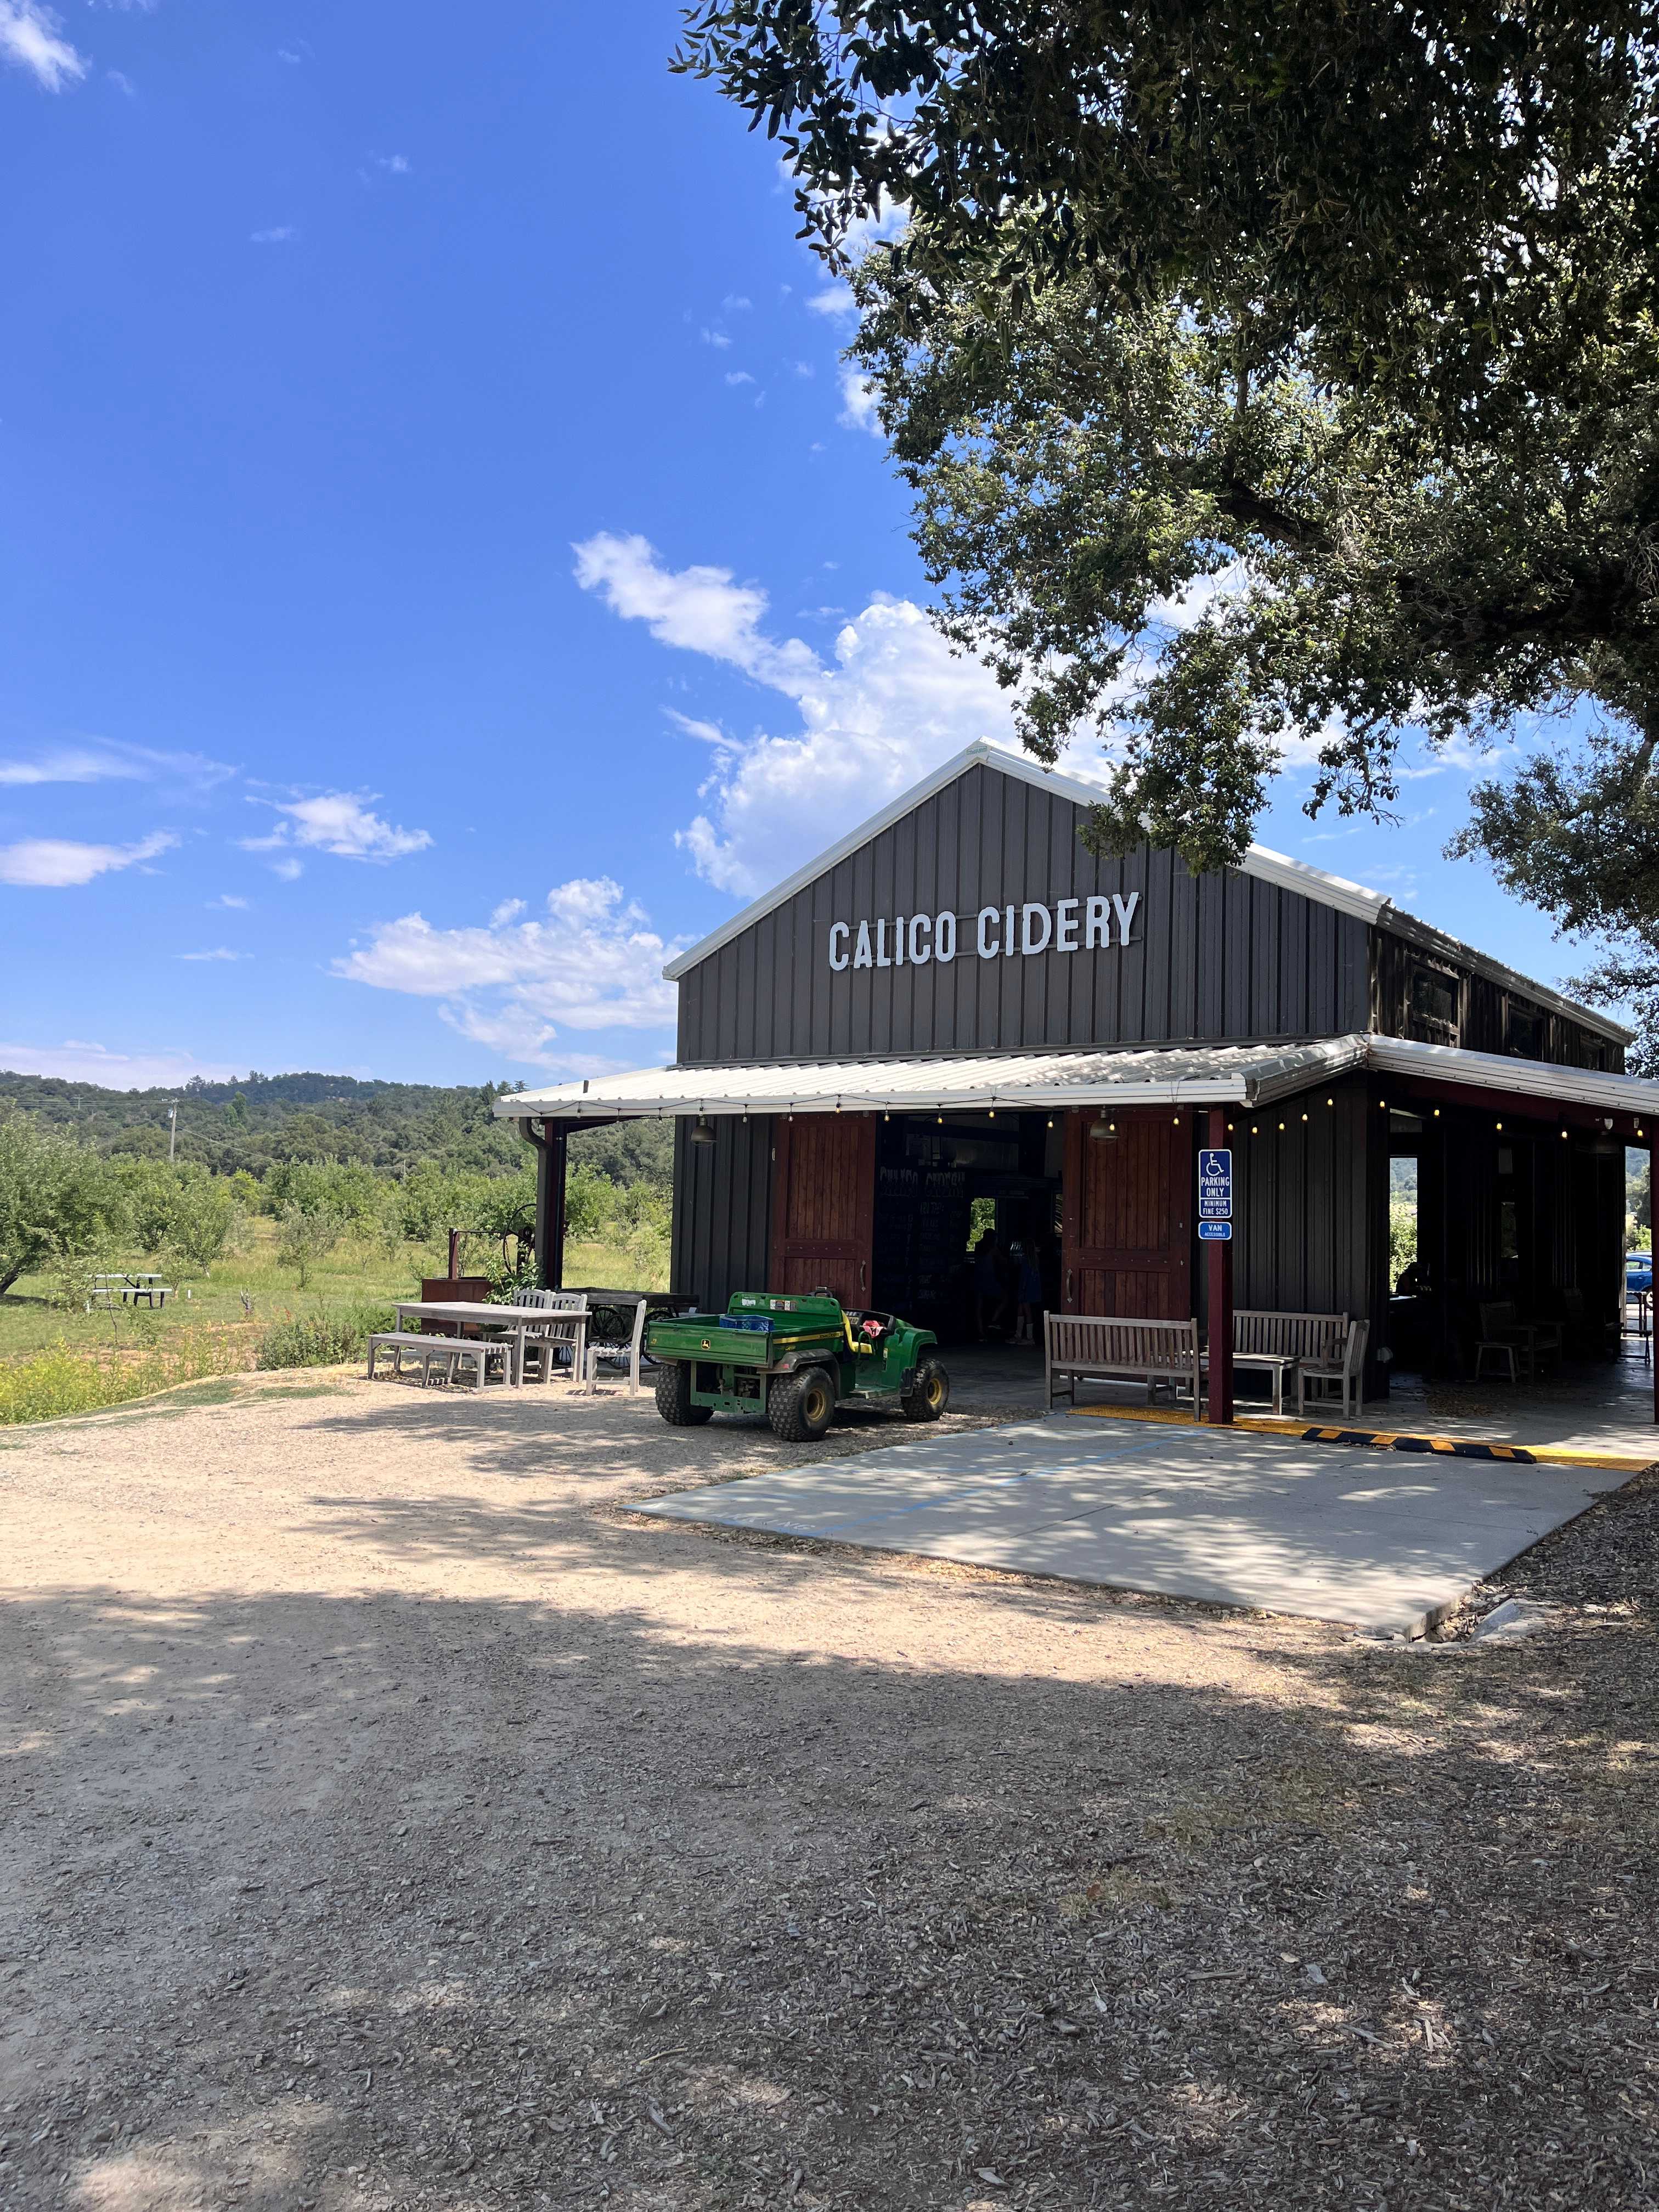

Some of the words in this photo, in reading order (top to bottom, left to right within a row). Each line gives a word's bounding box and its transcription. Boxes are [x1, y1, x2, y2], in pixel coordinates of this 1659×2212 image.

[829, 911, 956, 971] CALICO
[977, 891, 1139, 959] CIDERY
[1201, 1177, 1229, 1186] PARKING
[1206, 1187, 1224, 1197] ONLY
